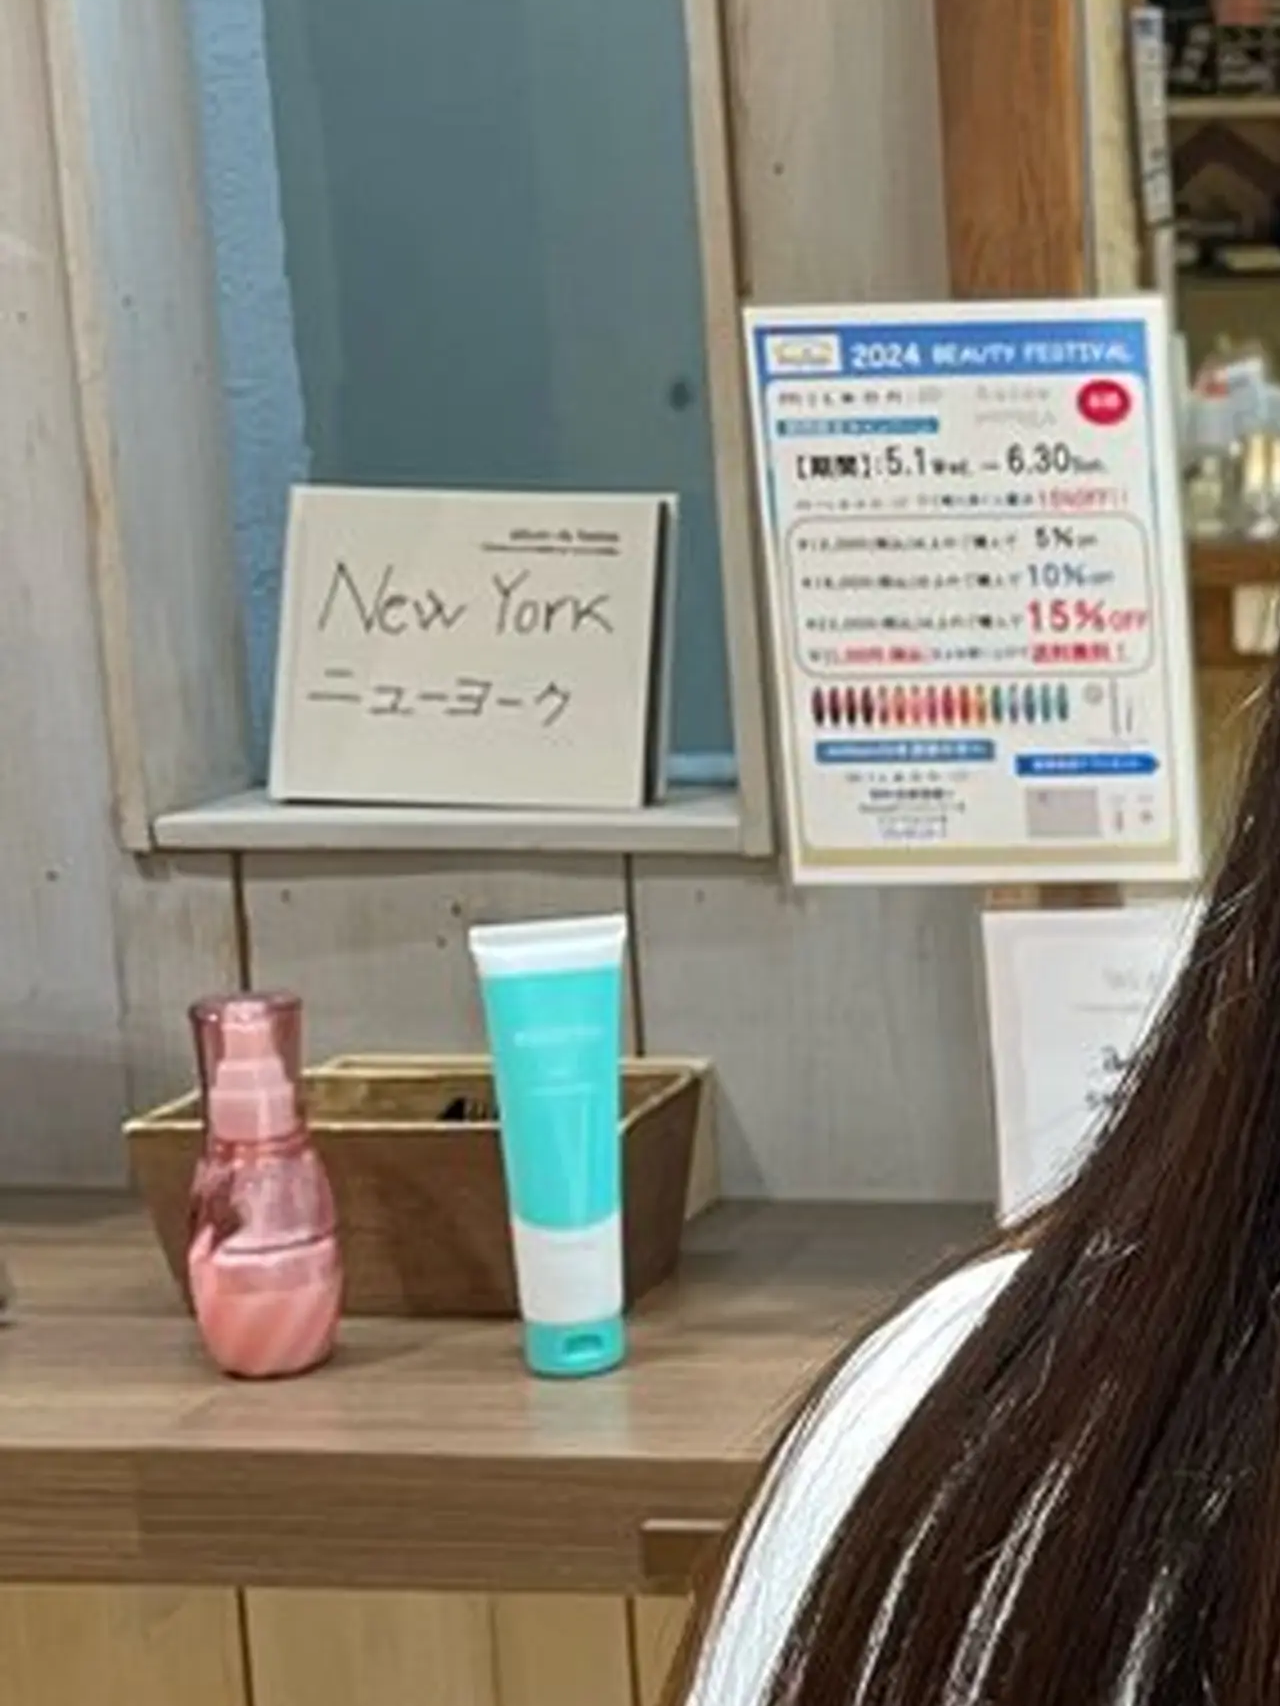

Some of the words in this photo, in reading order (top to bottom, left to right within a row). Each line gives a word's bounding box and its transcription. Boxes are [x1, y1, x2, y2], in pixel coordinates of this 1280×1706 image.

[851, 340, 921, 368] 2024
[932, 340, 1014, 366] BEAUTY
[1022, 337, 1135, 364] FESTIVAL
[1006, 443, 1070, 476] 6.30
[318, 560, 467, 635] New
[491, 568, 615, 635] York
[306, 667, 572, 727] ニューヨーク
